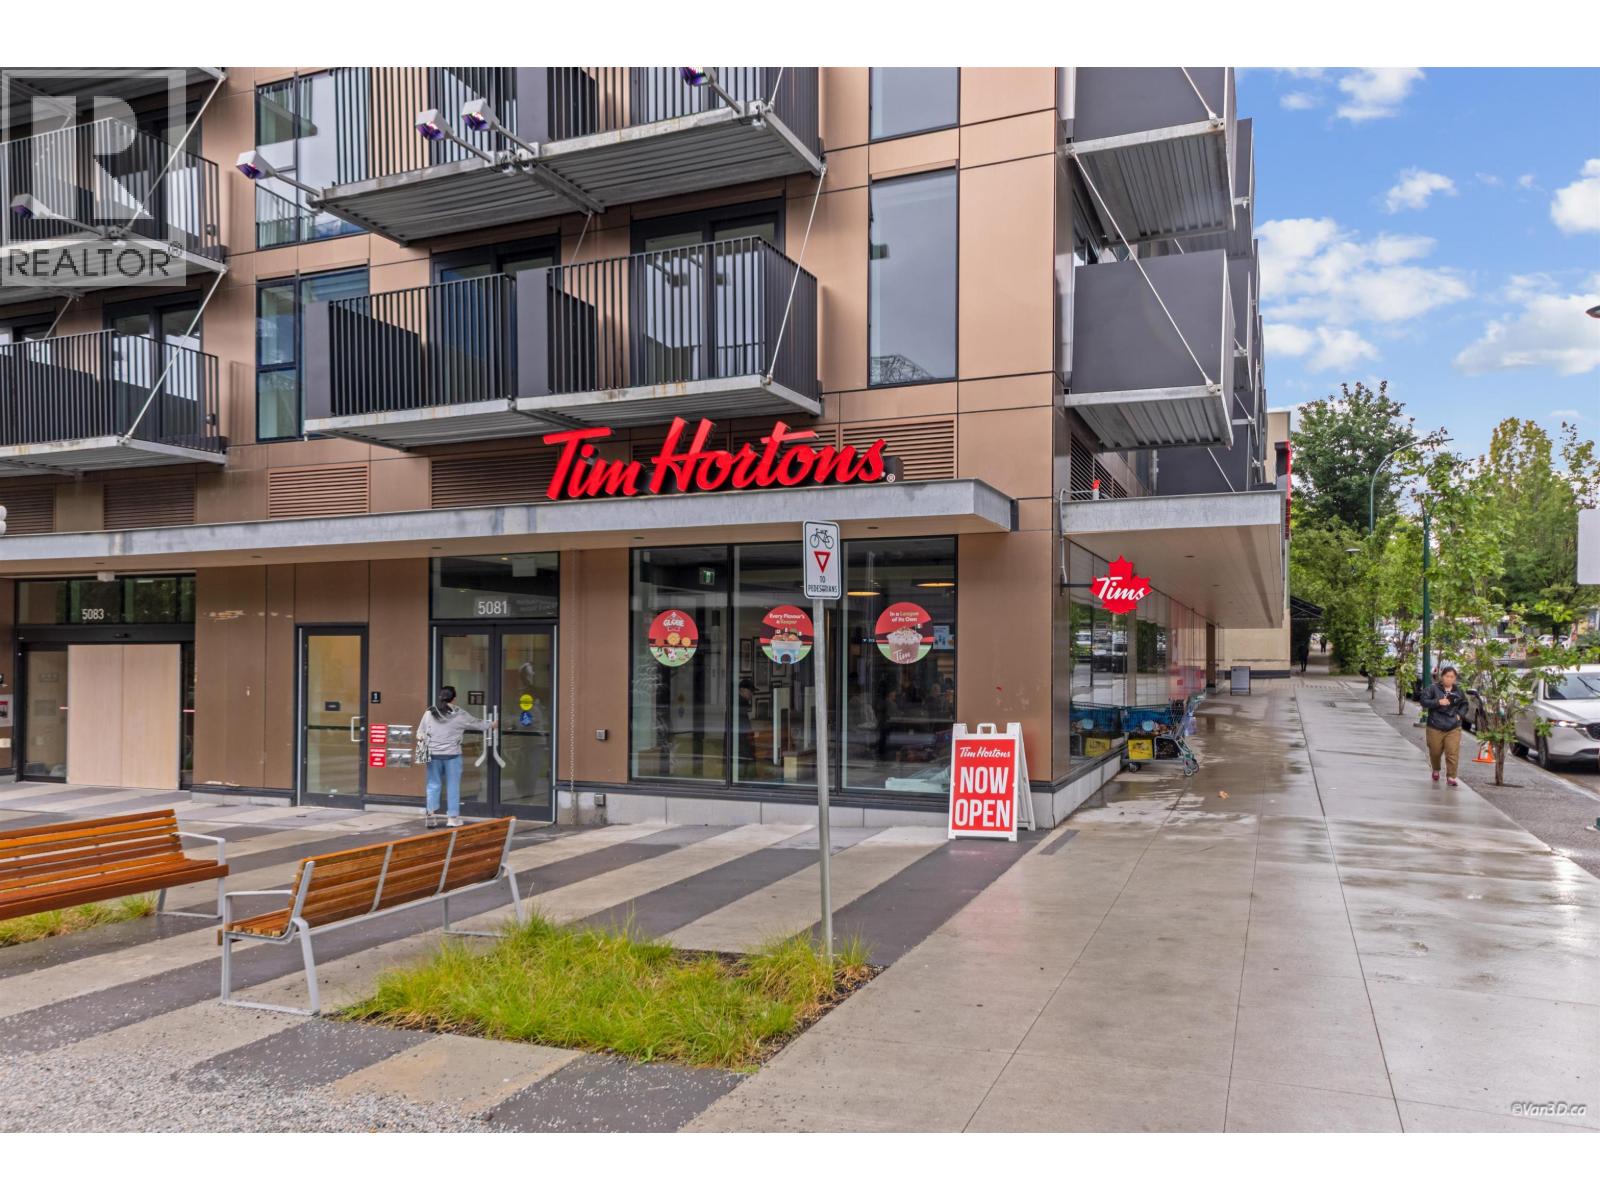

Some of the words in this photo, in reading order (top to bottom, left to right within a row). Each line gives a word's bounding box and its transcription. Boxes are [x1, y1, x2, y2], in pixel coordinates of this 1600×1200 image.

[543, 427, 645, 500] Tim
[1096, 576, 1145, 600] Tims
[82, 608, 105, 620] 5083
[478, 600, 508, 615] 5081
[960, 747, 976, 758] Tim
[976, 746, 1011, 758] Hortons
[959, 766, 1009, 794] NOW
[954, 799, 1011, 828] OPEN
